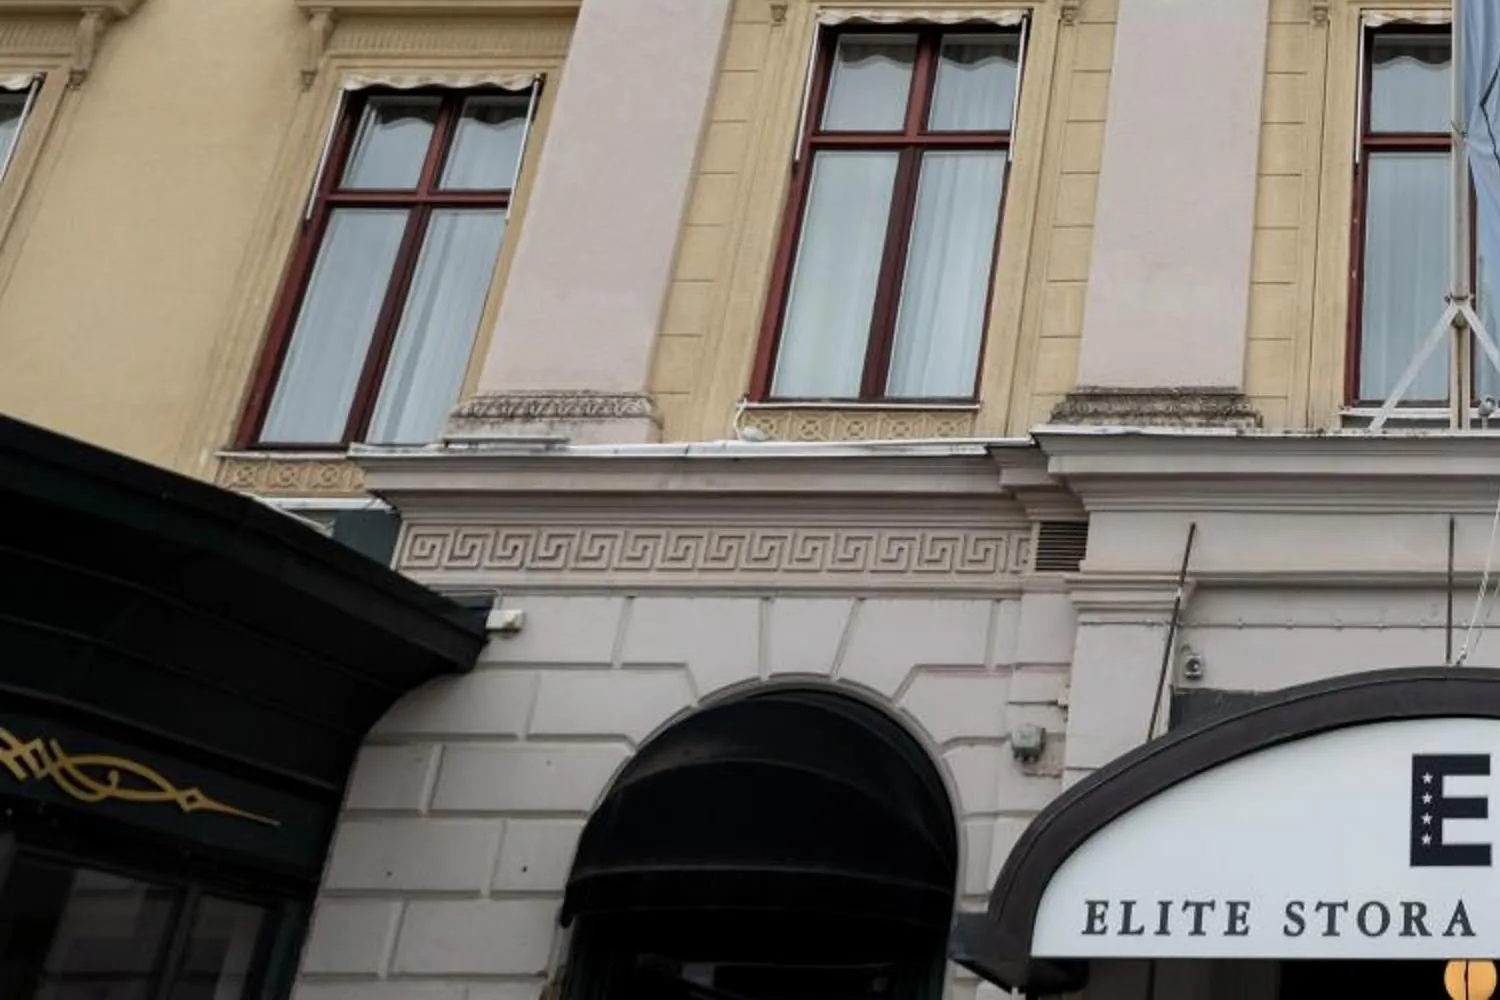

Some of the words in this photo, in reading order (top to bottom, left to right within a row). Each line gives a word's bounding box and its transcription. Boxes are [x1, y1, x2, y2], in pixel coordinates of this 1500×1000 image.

[1410, 753, 1493, 867] E
[1081, 900, 1250, 936] ELITE
[1283, 899, 1476, 937] STORA
